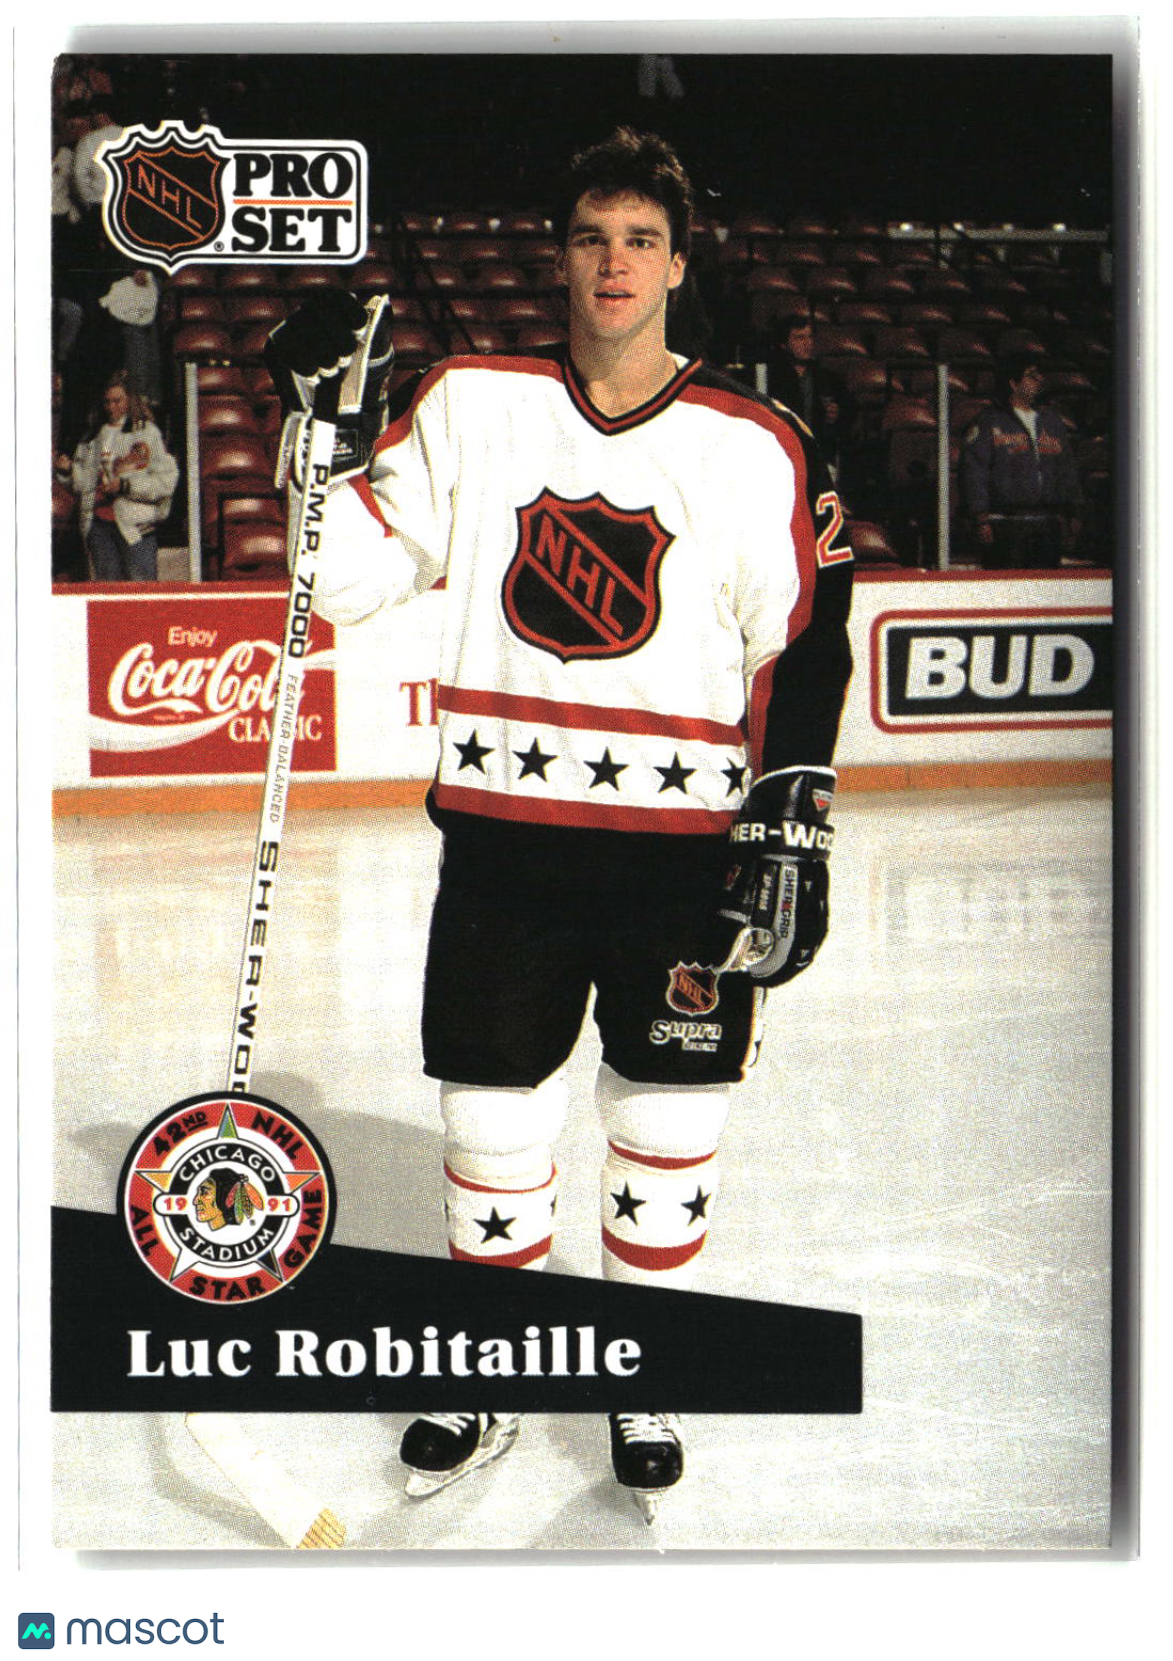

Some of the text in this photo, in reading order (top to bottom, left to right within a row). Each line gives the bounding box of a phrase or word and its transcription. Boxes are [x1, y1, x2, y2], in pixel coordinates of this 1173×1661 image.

[137, 163, 202, 229] NHL
[232, 152, 353, 199] PRO
[231, 206, 352, 252] SET
[816, 490, 854, 568] 2
[287, 463, 329, 659] P.M.P. 7000
[535, 513, 624, 636] NHL
[168, 626, 218, 648] Enjoy
[107, 639, 304, 716] Coca-Col
[904, 634, 1096, 700] BUD
[228, 713, 323, 743] CLAIC
[649, 1019, 723, 1045] Supra
[252, 1111, 304, 1160] NHL
[179, 1145, 276, 1182] CHICAGO
[163, 1197, 292, 1212] 19 91
[130, 1188, 323, 1301] ALL STAR GAME
[179, 1227, 275, 1261] STADIUM
[127, 1326, 642, 1377] Luc Robitaille
